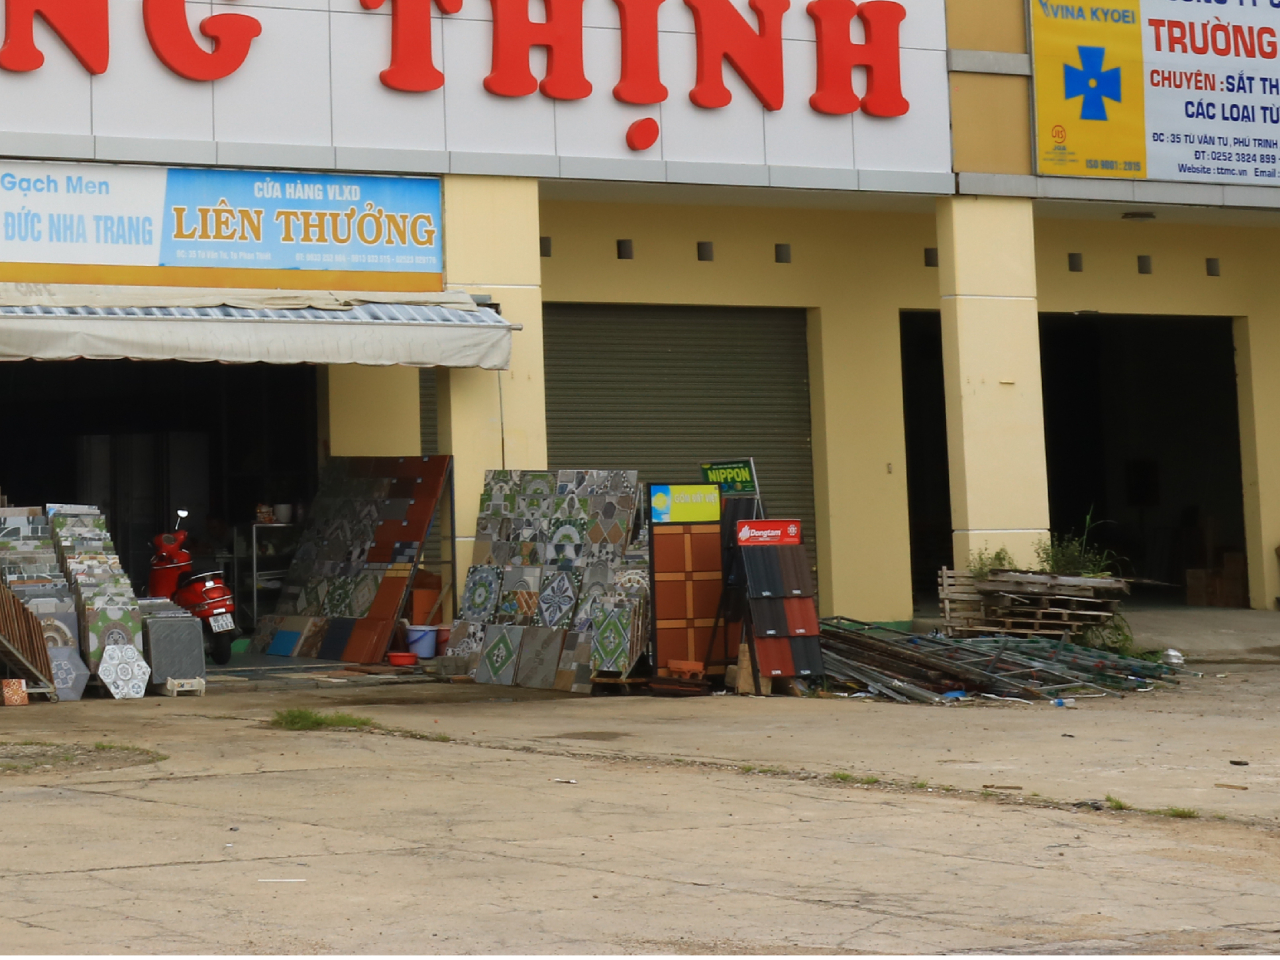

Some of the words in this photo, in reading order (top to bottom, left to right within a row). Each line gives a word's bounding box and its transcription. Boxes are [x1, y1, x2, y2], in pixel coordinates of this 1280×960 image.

[1051, 4, 1086, 20] VINA
[1091, 7, 1136, 24] KYOEI
[1148, 16, 1278, 59] TRƯỜNG
[1150, 69, 1216, 91] CHUYÊN
[1185, 98, 1216, 119] CÁC
[1221, 103, 1256, 122] LOẠI
[1086, 160, 1099, 169] ISO
[1235, 153, 1256, 163] 3824
[1260, 154, 1276, 163] 899
[0, 172, 58, 197] Gạch
[66, 175, 110, 194] Men
[254, 177, 282, 199] CỬA
[286, 180, 323, 200] HÀNG
[327, 185, 360, 201] VLXD
[4, 205, 41, 242] ĐỨC
[48, 213, 88, 243] NHA
[93, 215, 153, 245] TRANG
[171, 198, 265, 242] LIÊN
[274, 200, 437, 247] THƯỞNG
[708, 467, 750, 482] NIPPON
[751, 529, 781, 537] Dongtam
